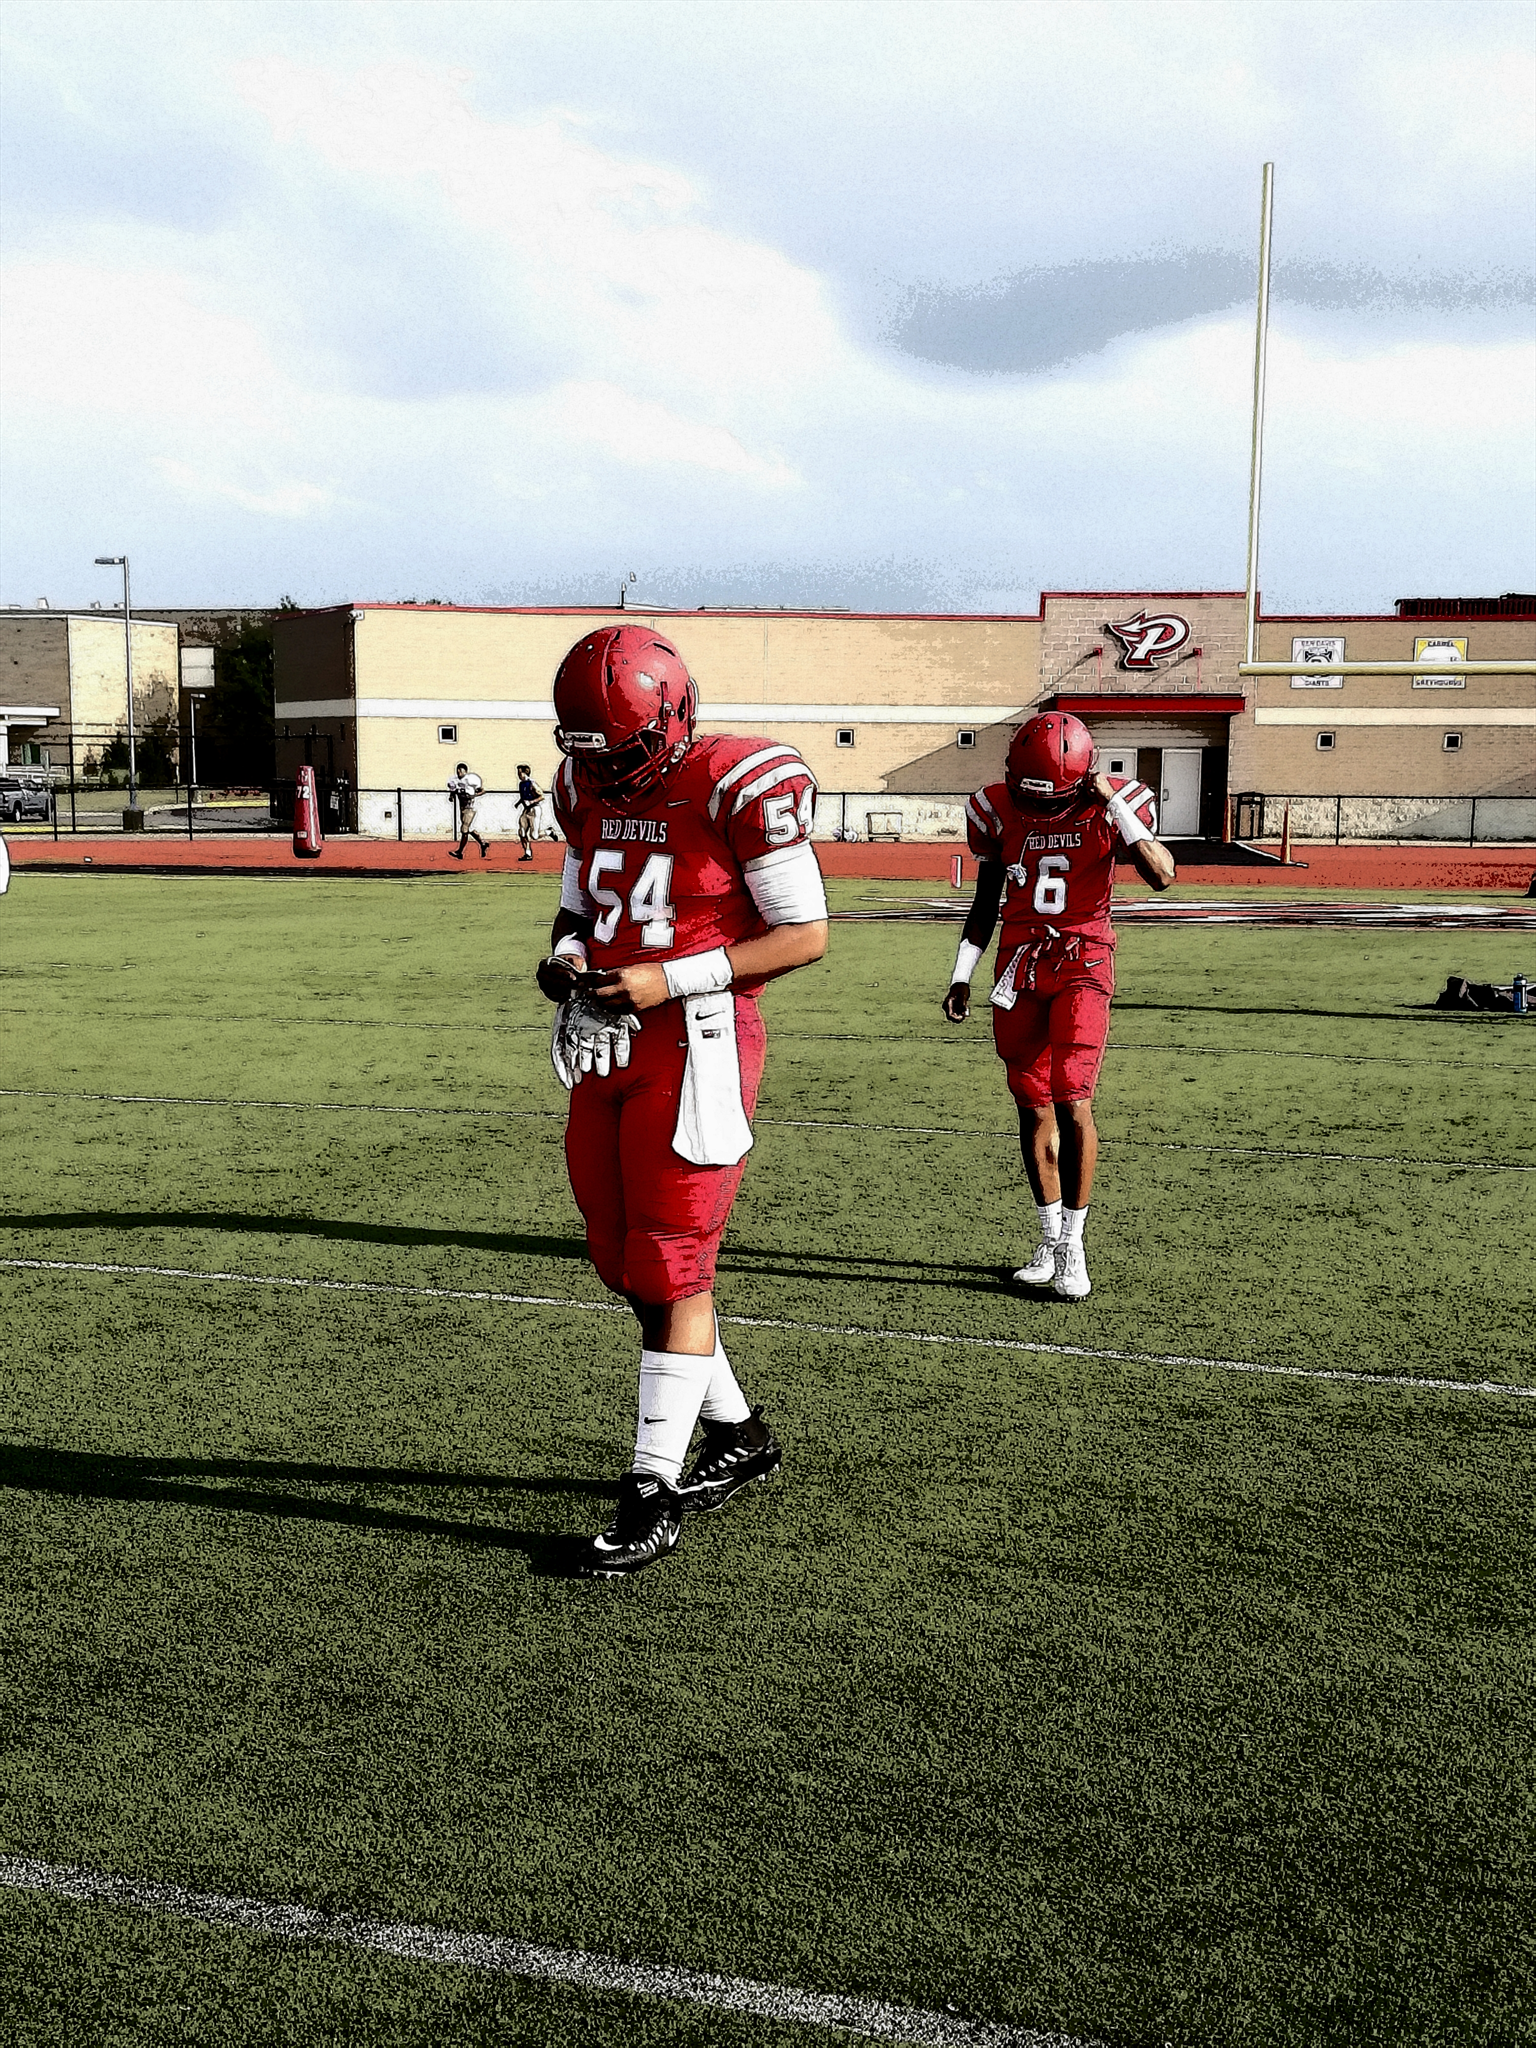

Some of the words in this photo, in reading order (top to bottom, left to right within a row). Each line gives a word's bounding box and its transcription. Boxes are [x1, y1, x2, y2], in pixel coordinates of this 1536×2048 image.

[296, 785, 310, 799] 72
[601, 818, 622, 840] RED
[621, 819, 668, 843] DEVILS
[1028, 836, 1046, 850] RED
[1047, 833, 1081, 849] DEVILS
[1033, 854, 1069, 914] 6
[588, 849, 676, 948] 54
